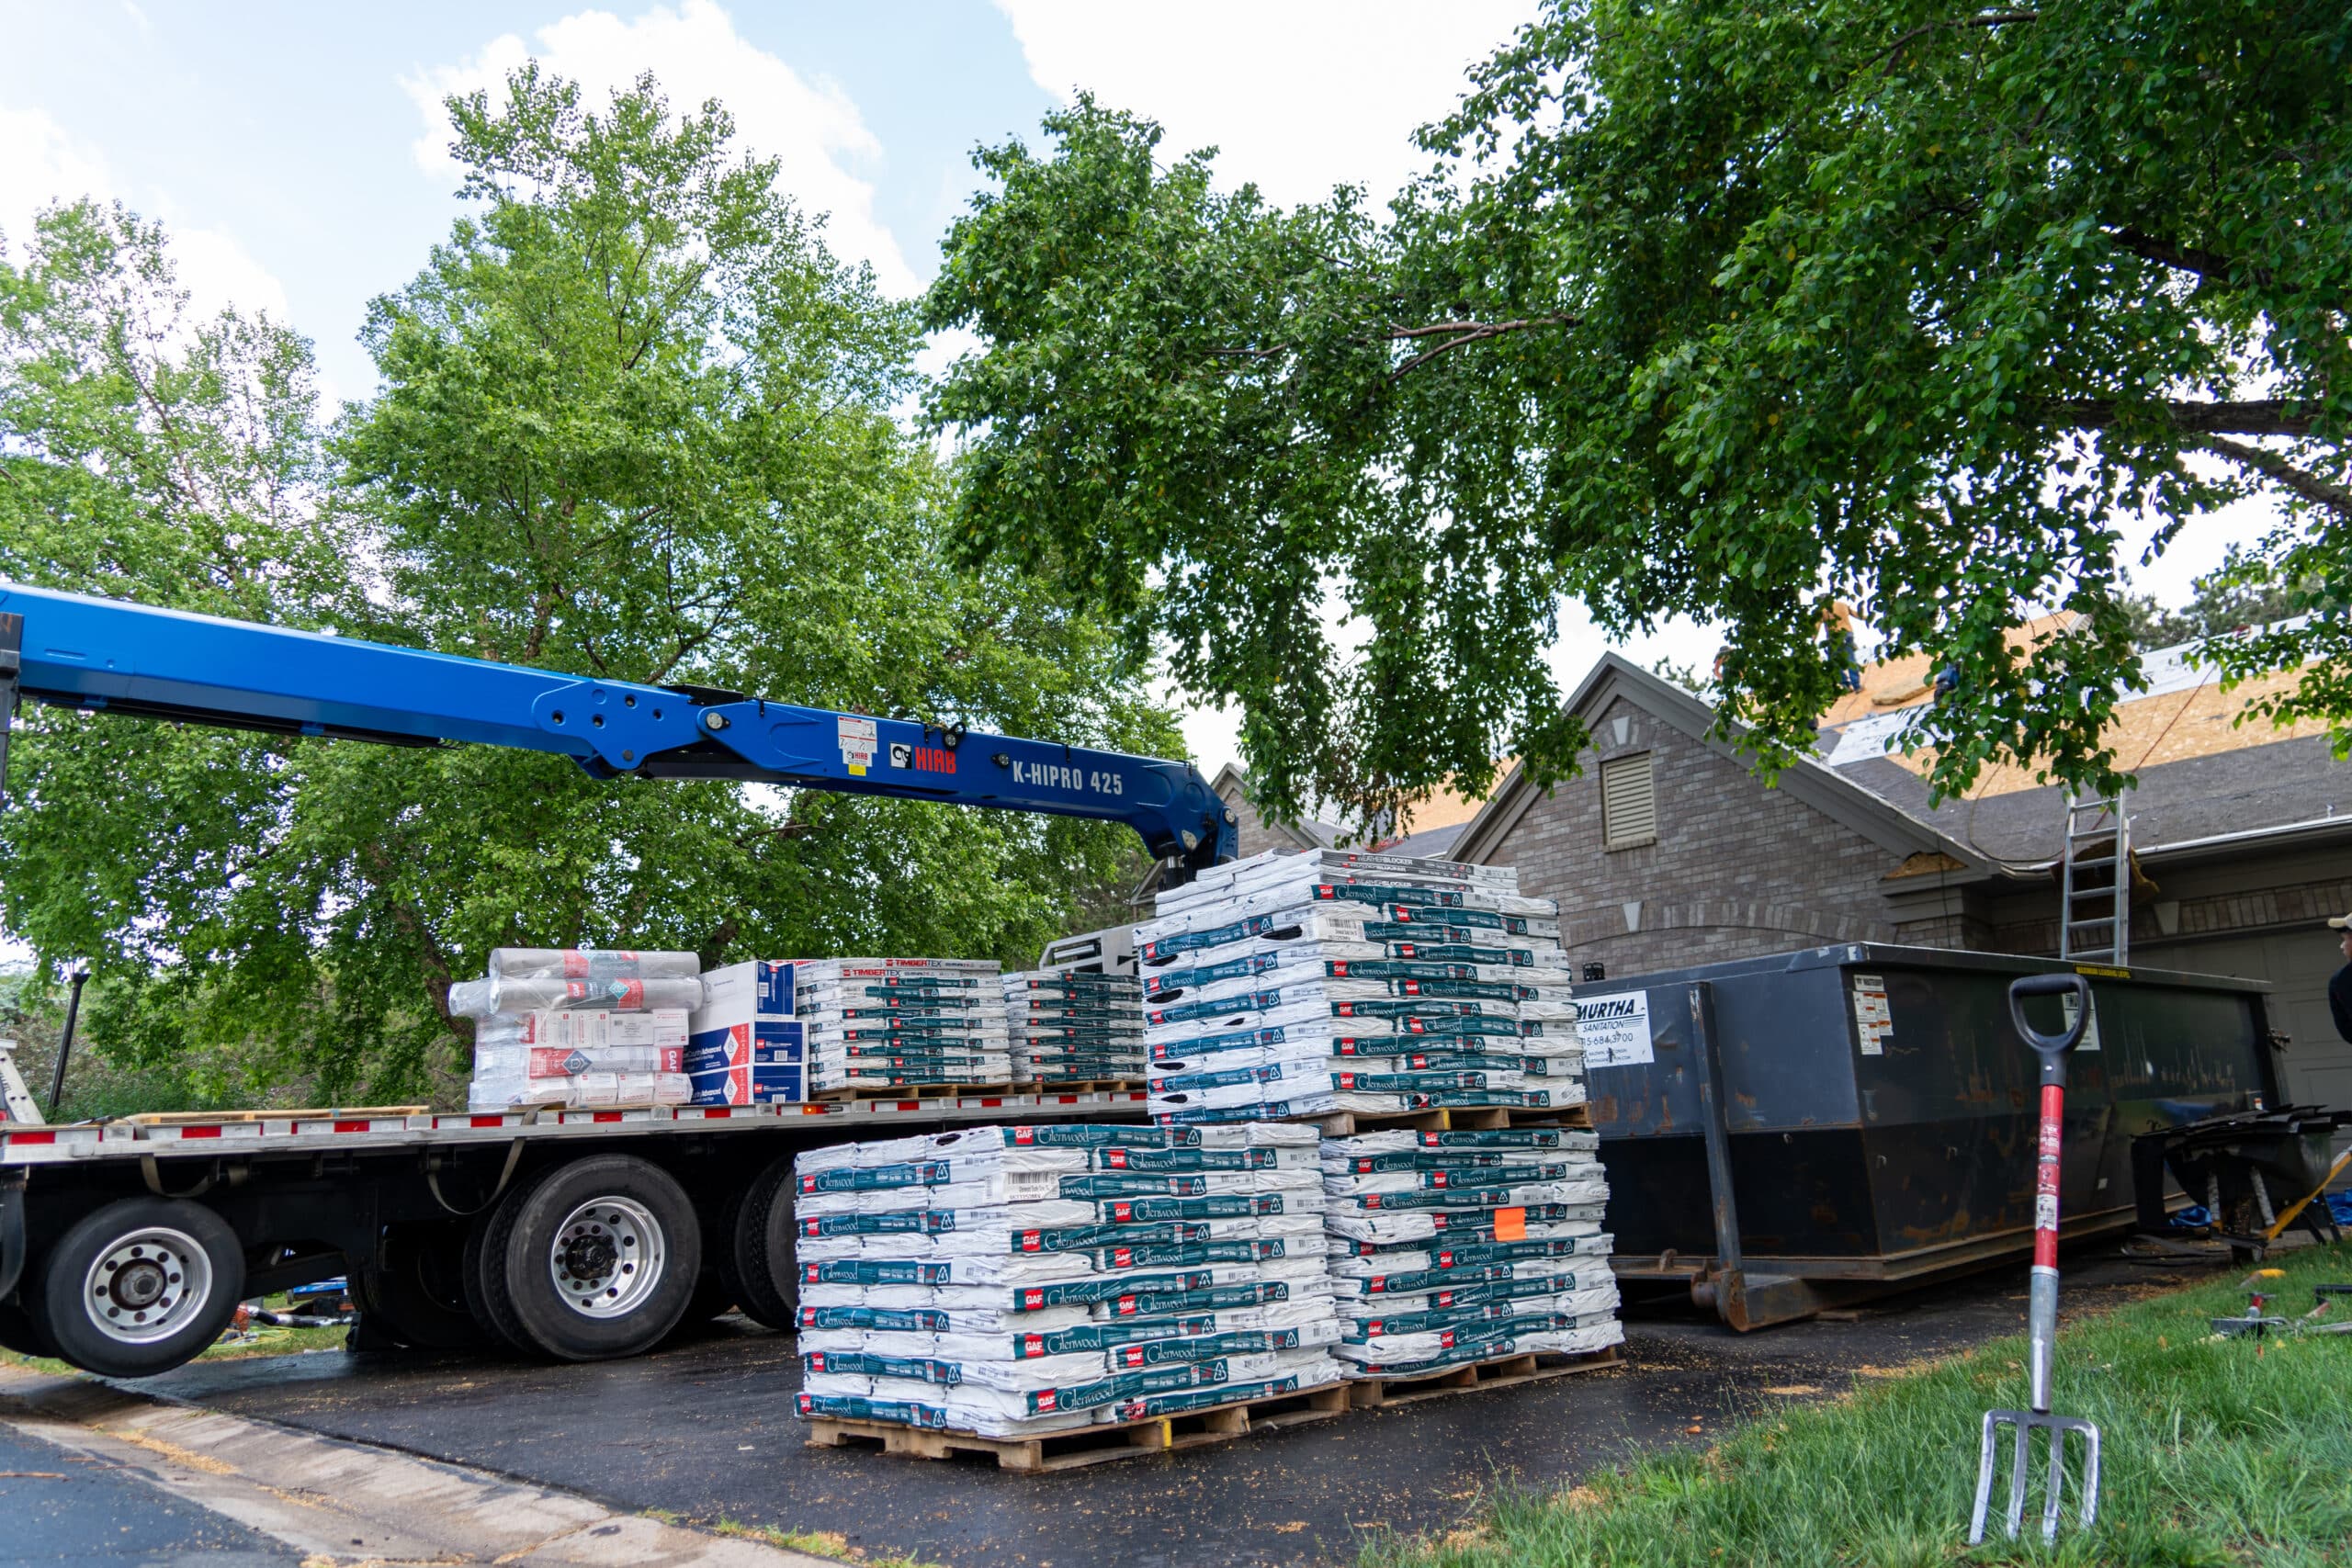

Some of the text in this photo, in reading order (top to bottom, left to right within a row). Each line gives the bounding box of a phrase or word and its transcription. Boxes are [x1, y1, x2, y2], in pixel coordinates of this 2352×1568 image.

[854, 752, 868, 761] HIAB
[915, 746, 956, 773] HIAB
[1012, 761, 1123, 795] K-HIPRO 425
[1337, 886, 1376, 901] Glenwood
[895, 959, 942, 967] TIMBERTEX
[1577, 998, 1634, 1021] MURTHA
[1583, 1021, 1625, 1032] SANITATION
[1357, 1037, 1397, 1055] Glenwood
[668, 1050, 677, 1073] GAF
[1357, 1073, 1397, 1089] Glenwood
[1016, 1125, 1089, 1145] GAF Glenwood
[1441, 1132, 1479, 1145] Glenwood
[1129, 1150, 1176, 1170] Glenwood
[1374, 1155, 1416, 1172] Glenwood
[818, 1170, 854, 1190] Glenwood
[1449, 1171, 1487, 1187] Glenwood
[1115, 1201, 1182, 1221] GAF Glenwood
[821, 1214, 858, 1235] Glenwood
[1023, 1227, 1098, 1250] GAF Glenwood
[1135, 1246, 1183, 1266] Glenwood
[1455, 1247, 1493, 1265] Glenwood
[820, 1262, 858, 1281] Glenwood
[1025, 1283, 1101, 1307] GAF Glenwood
[1119, 1292, 1188, 1314] GAF Glenwood
[1025, 1328, 1102, 1354] GAF Glenwood
[1126, 1340, 1196, 1363] GAF Glenwood
[827, 1355, 865, 1372] Glenwood
[1038, 1378, 1114, 1411] GAF Glenwood
